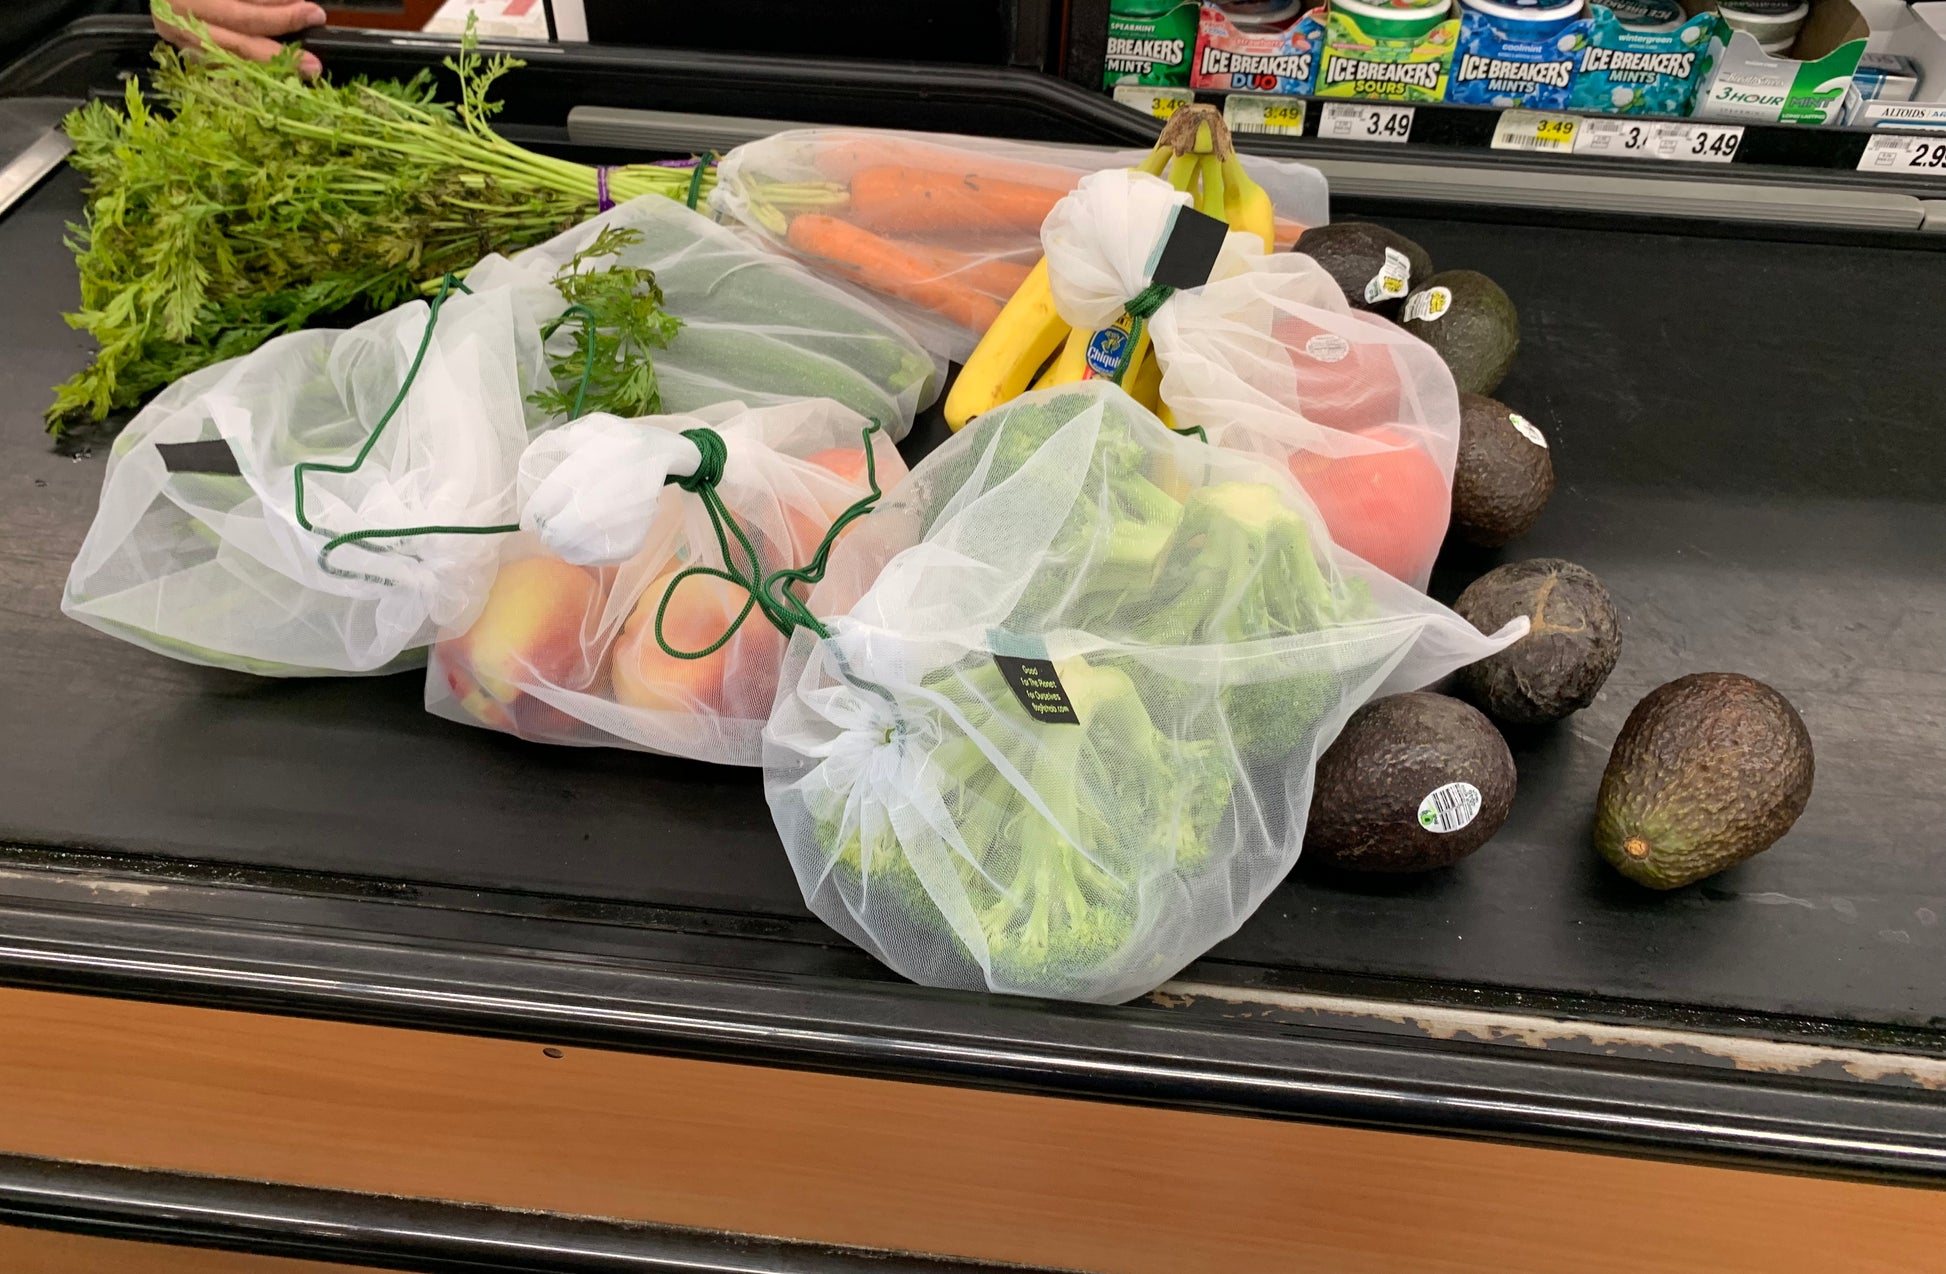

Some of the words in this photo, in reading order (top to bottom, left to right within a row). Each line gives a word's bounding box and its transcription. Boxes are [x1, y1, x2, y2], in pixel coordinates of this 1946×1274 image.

[1110, 22, 1155, 33] SPEARMINT
[1618, 33, 1673, 44] wintergreen
[1107, 36, 1185, 64] BREAKERS
[1501, 43, 1543, 54] coolmint
[1108, 60, 1152, 73] MINTS
[1201, 47, 1231, 75] ICE
[1229, 52, 1312, 80] BREAKERS
[1580, 46, 1611, 72] ICE
[1610, 51, 1695, 78] BREAKERS
[1327, 56, 1358, 84] ICE
[1356, 61, 1440, 89] BREAKERS
[1458, 54, 1490, 82] ICE
[1488, 60, 1573, 87] BREAKERS
[1608, 70, 1656, 84] MINTS
[1231, 73, 1278, 90] DUO
[1354, 80, 1406, 94] SOURS
[1488, 79, 1536, 93] MINTS
[1716, 87, 1733, 101] 3
[1731, 93, 1784, 106] HOUR
[1789, 96, 1835, 109] MINT
[1263, 107, 1299, 120] 3.49
[1882, 107, 1925, 119] ALTOIDS
[1367, 112, 1410, 137] 3.49
[1537, 119, 1574, 134] 3.49
[1625, 126, 1649, 150] 3.
[1692, 132, 1739, 157] 3.49
[1908, 143, 1946, 169] 2.9
